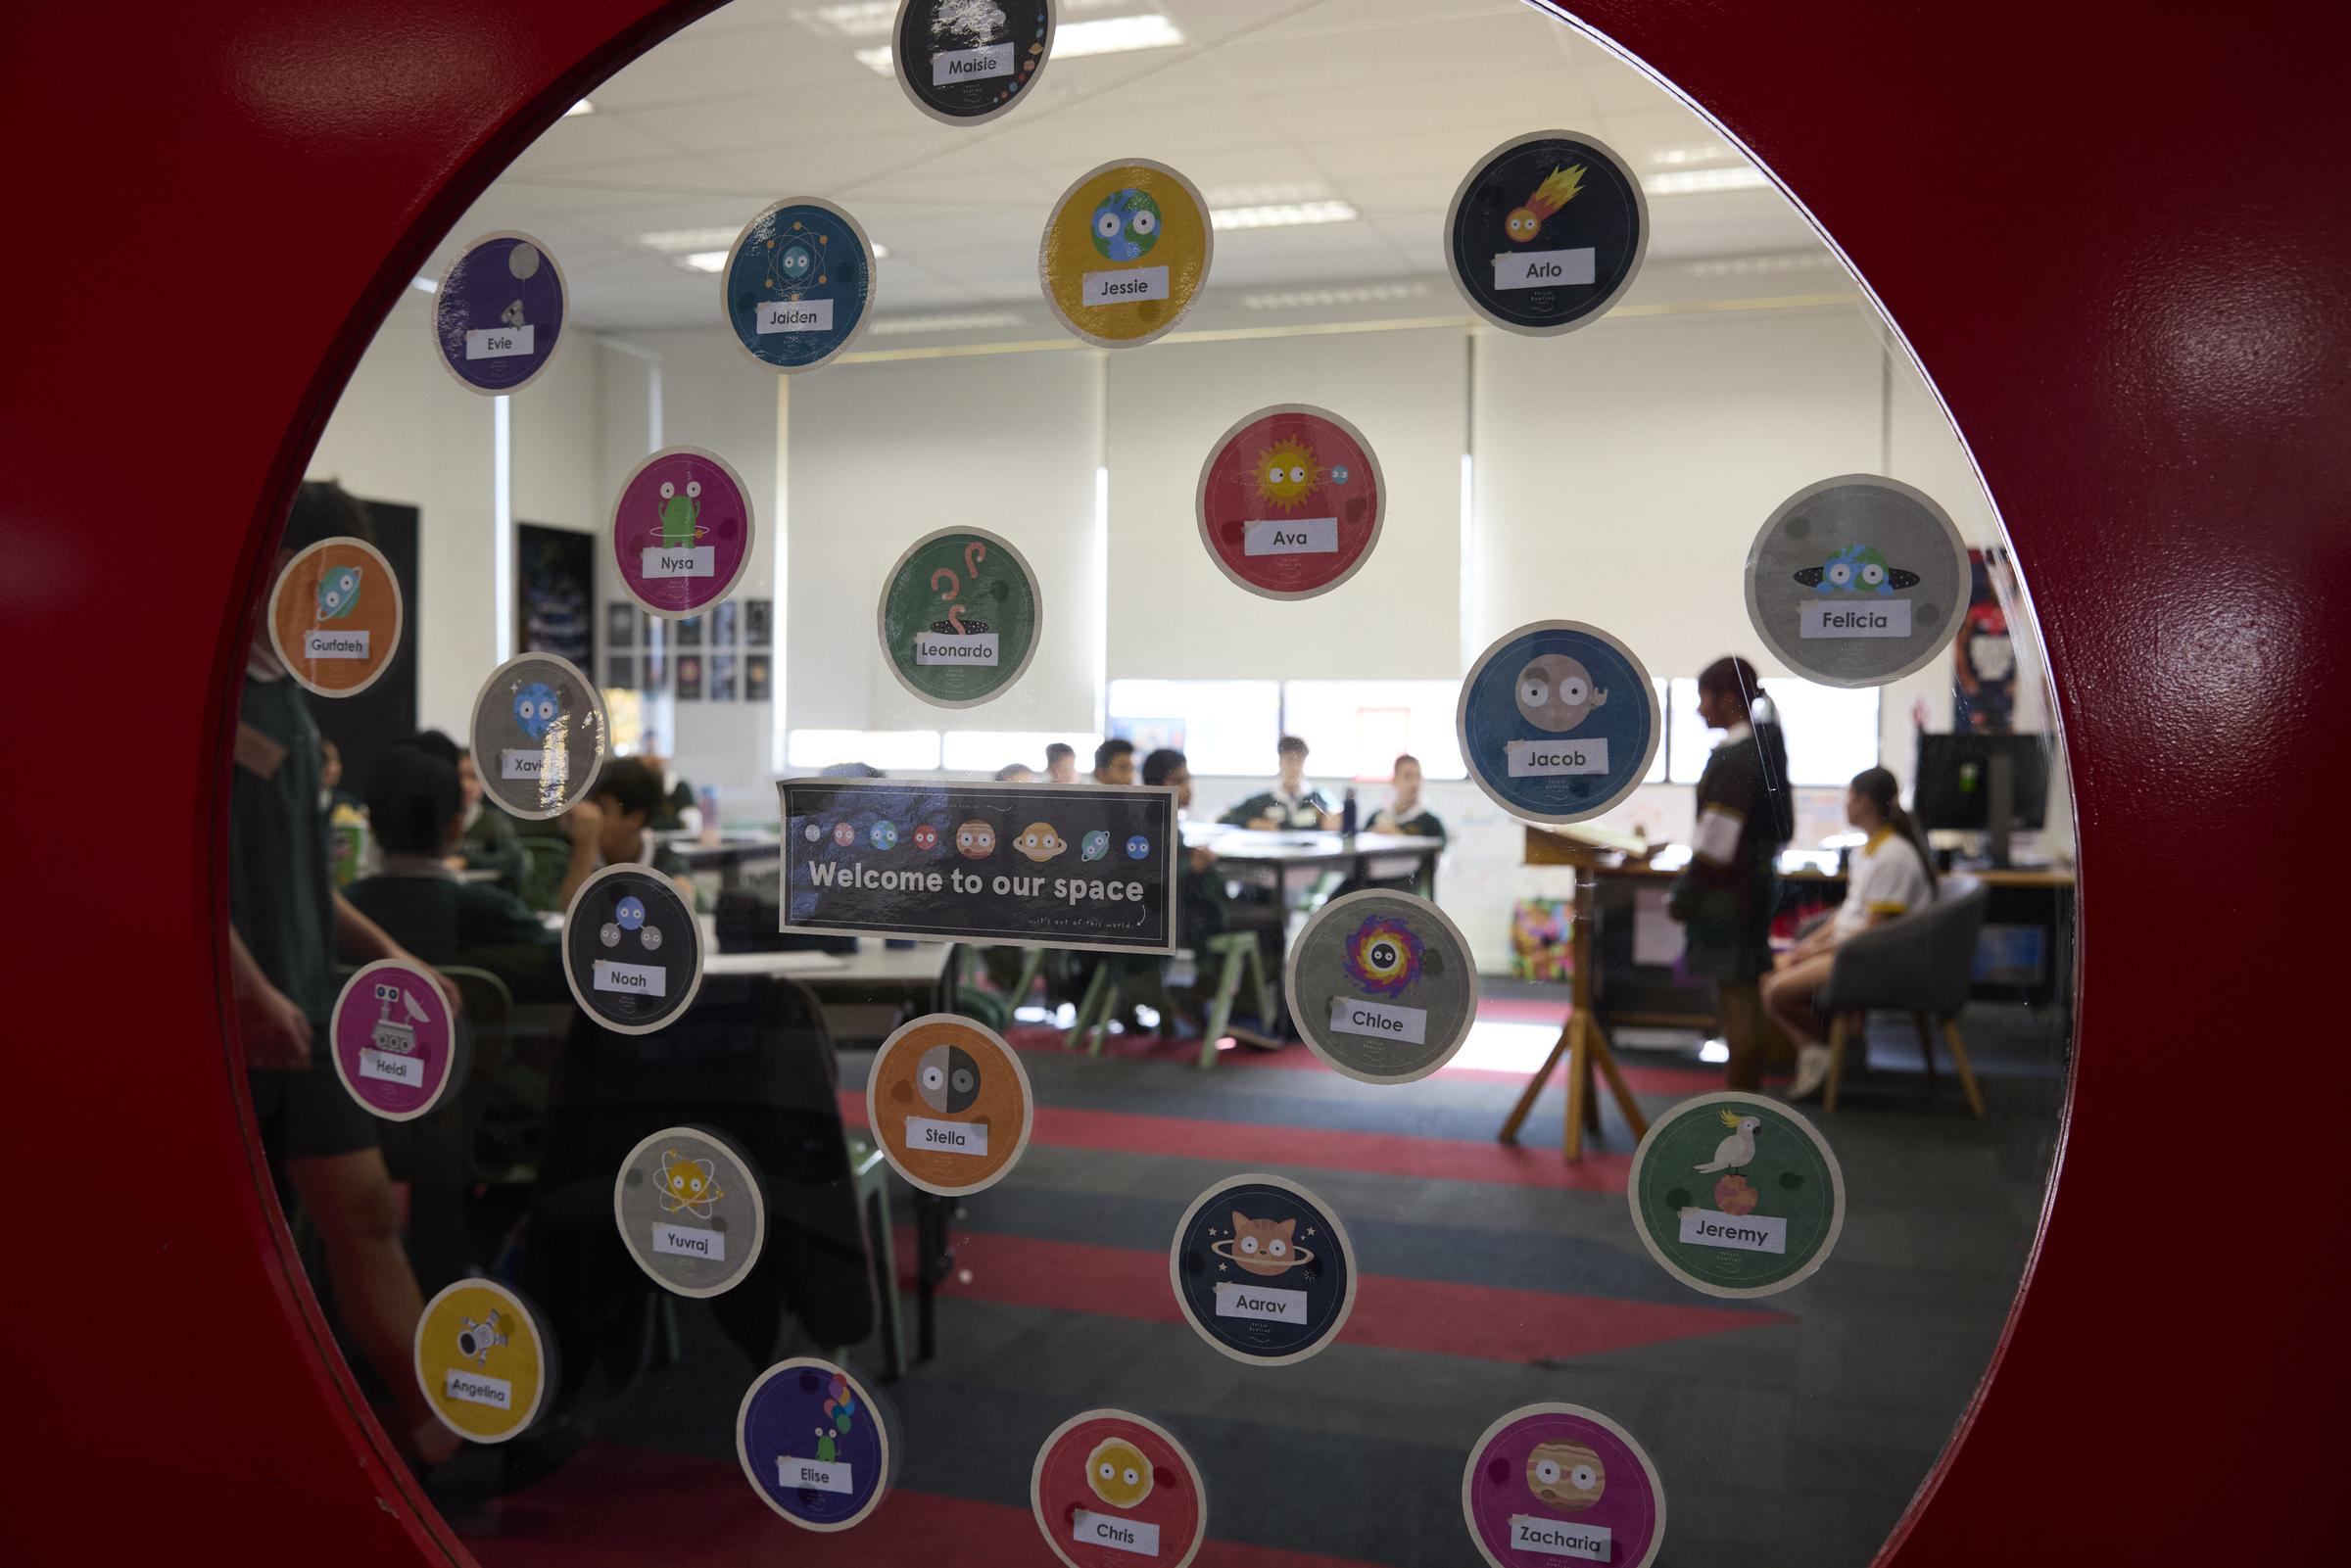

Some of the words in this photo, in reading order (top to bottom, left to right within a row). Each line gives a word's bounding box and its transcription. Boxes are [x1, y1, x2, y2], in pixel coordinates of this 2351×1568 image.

[948, 56, 997, 75] Maisie
[1525, 261, 1562, 278] Arlo
[1101, 278, 1149, 296] Jessie
[770, 310, 817, 325] Jaiden
[487, 336, 512, 351] Evie
[1272, 531, 1308, 546] Ava
[661, 556, 695, 573] Nysa
[1822, 611, 1888, 629] Felicia
[311, 639, 363, 653] Gurfateh
[921, 641, 992, 658] Leonardo
[1527, 750, 1586, 767] Jacob
[808, 860, 943, 892] Welcome
[950, 867, 984, 894] to
[992, 876, 1045, 897] our
[1053, 877, 1144, 906] space
[611, 971, 647, 988] Noah
[1351, 1010, 1405, 1034] Chloe
[376, 1059, 408, 1079] Heidi
[925, 1128, 966, 1146] Stella
[1696, 1219, 1769, 1247] Jeremy
[666, 1232, 710, 1257] Yuvraj
[1235, 1295, 1287, 1313] Aarav
[452, 1377, 505, 1402] Angelina
[800, 1467, 830, 1484] Elise
[1096, 1524, 1135, 1545] Chris
[1519, 1526, 1602, 1553] Zacharia
